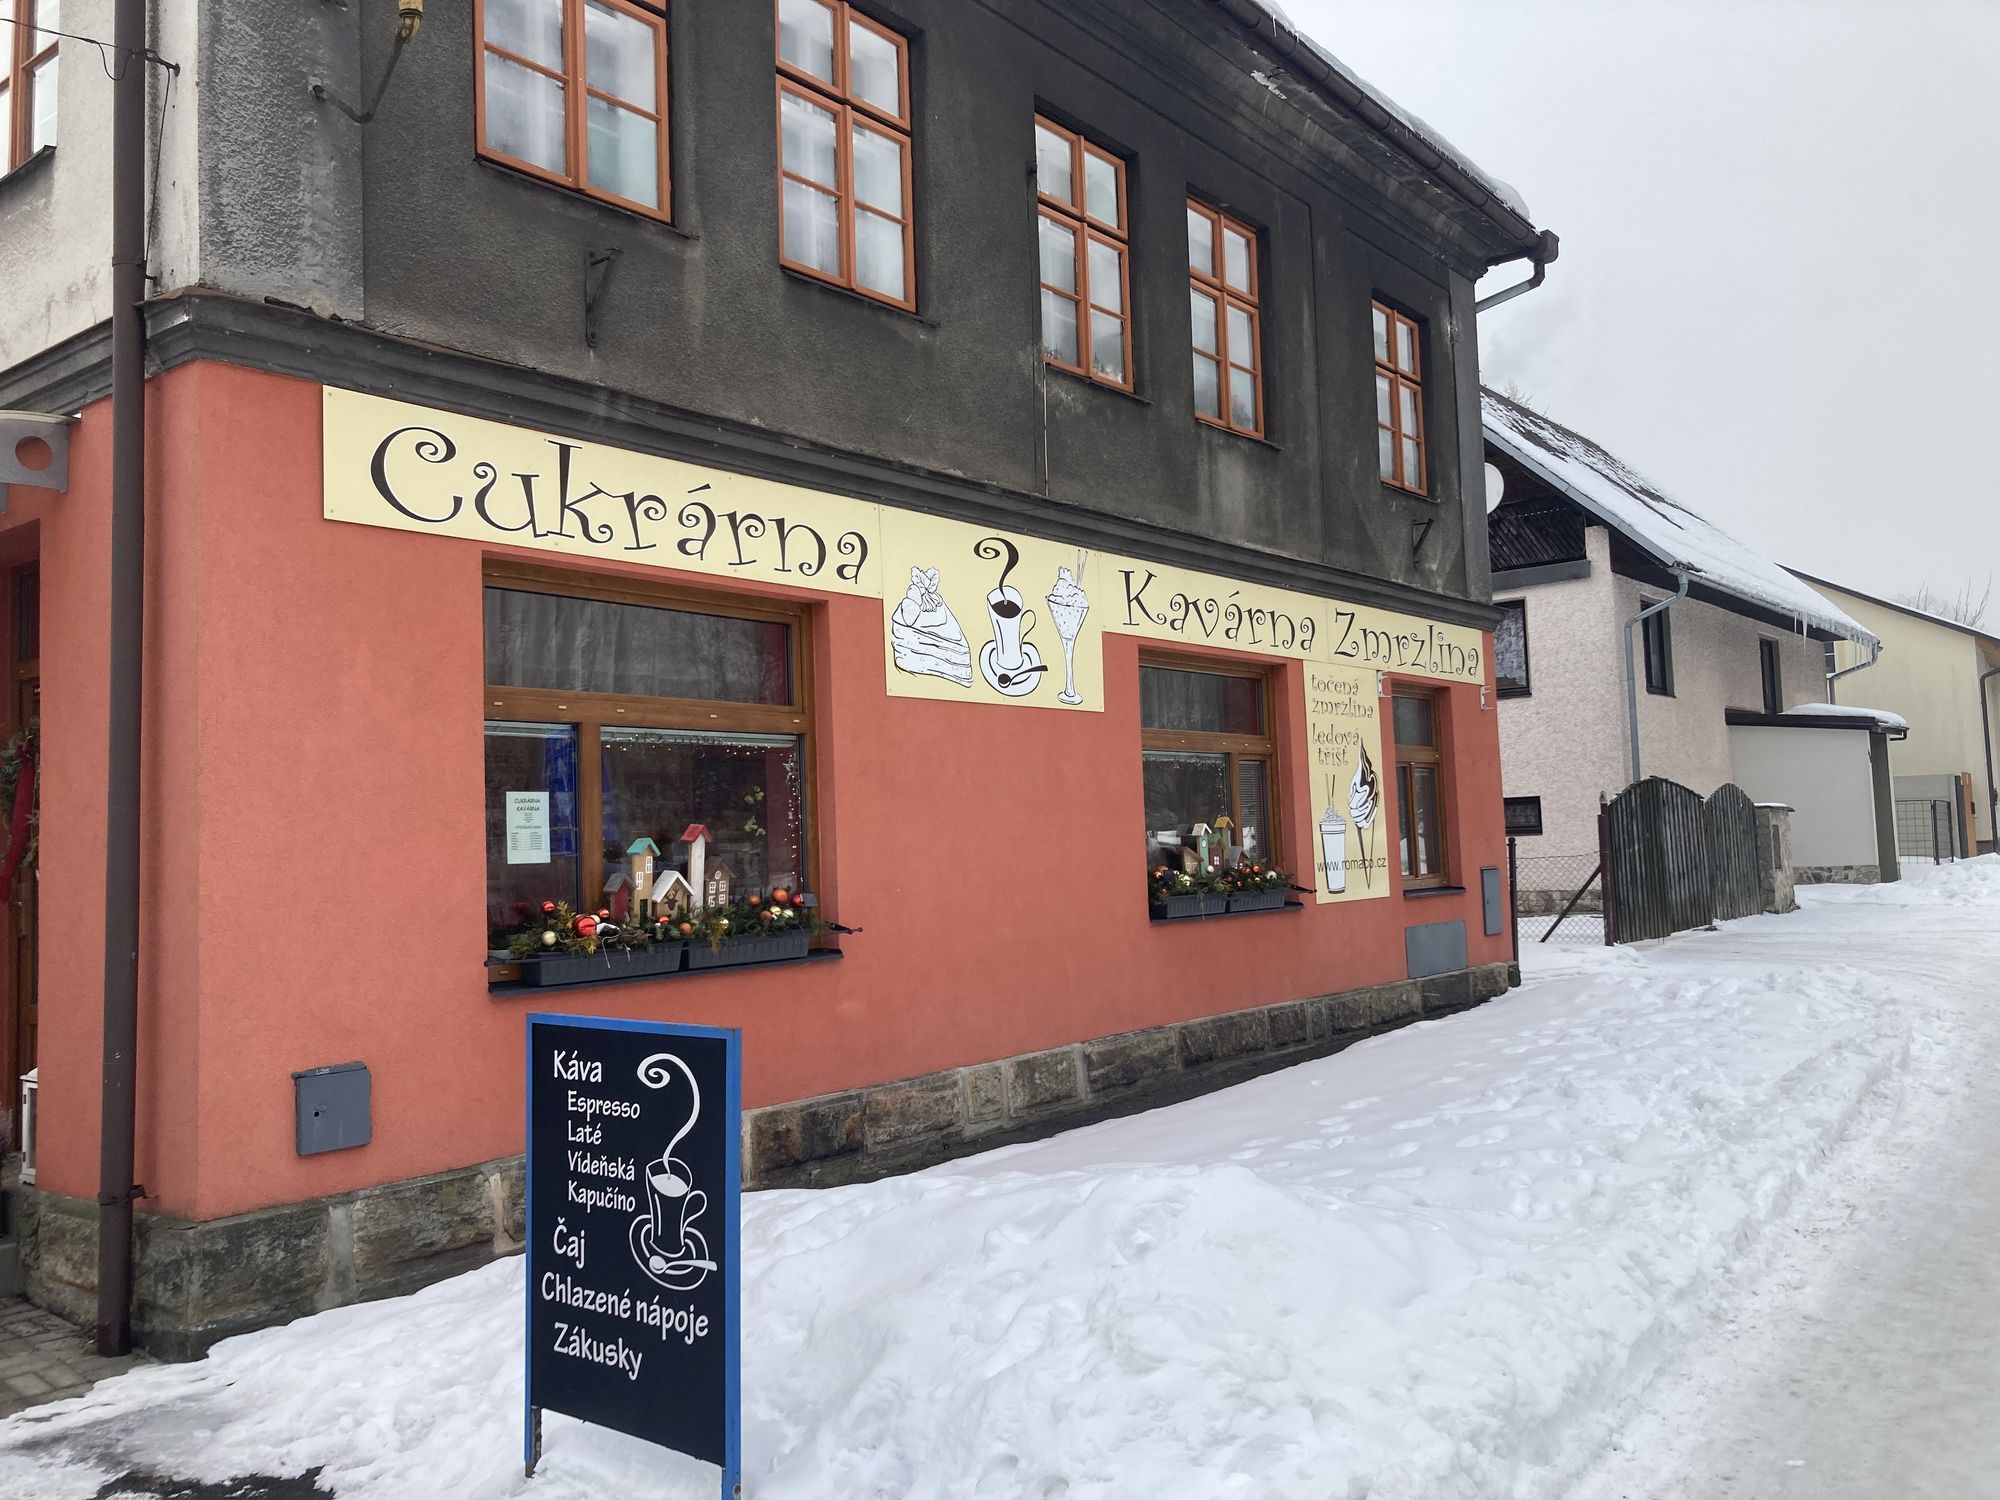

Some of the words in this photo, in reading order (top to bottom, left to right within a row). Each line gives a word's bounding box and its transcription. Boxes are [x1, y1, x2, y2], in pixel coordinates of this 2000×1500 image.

[370, 426, 869, 585] Cukrárna
[1118, 569, 1316, 653] Kavárna
[1334, 607, 1479, 678] Zmrzlina
[1311, 674, 1359, 696] točená
[1312, 697, 1374, 718] zmrzlina
[1312, 722, 1360, 746] ledová
[553, 1050, 602, 1084] Káva
[567, 1090, 640, 1122] Espresso
[567, 1120, 602, 1145] Laté
[567, 1150, 635, 1182] Vídeňská
[567, 1179, 636, 1213] Kapučíno
[553, 1216, 586, 1269] Čaj
[541, 1270, 631, 1320] Chlazené
[635, 1295, 710, 1346] nápoje
[553, 1321, 643, 1382] Zákusky
